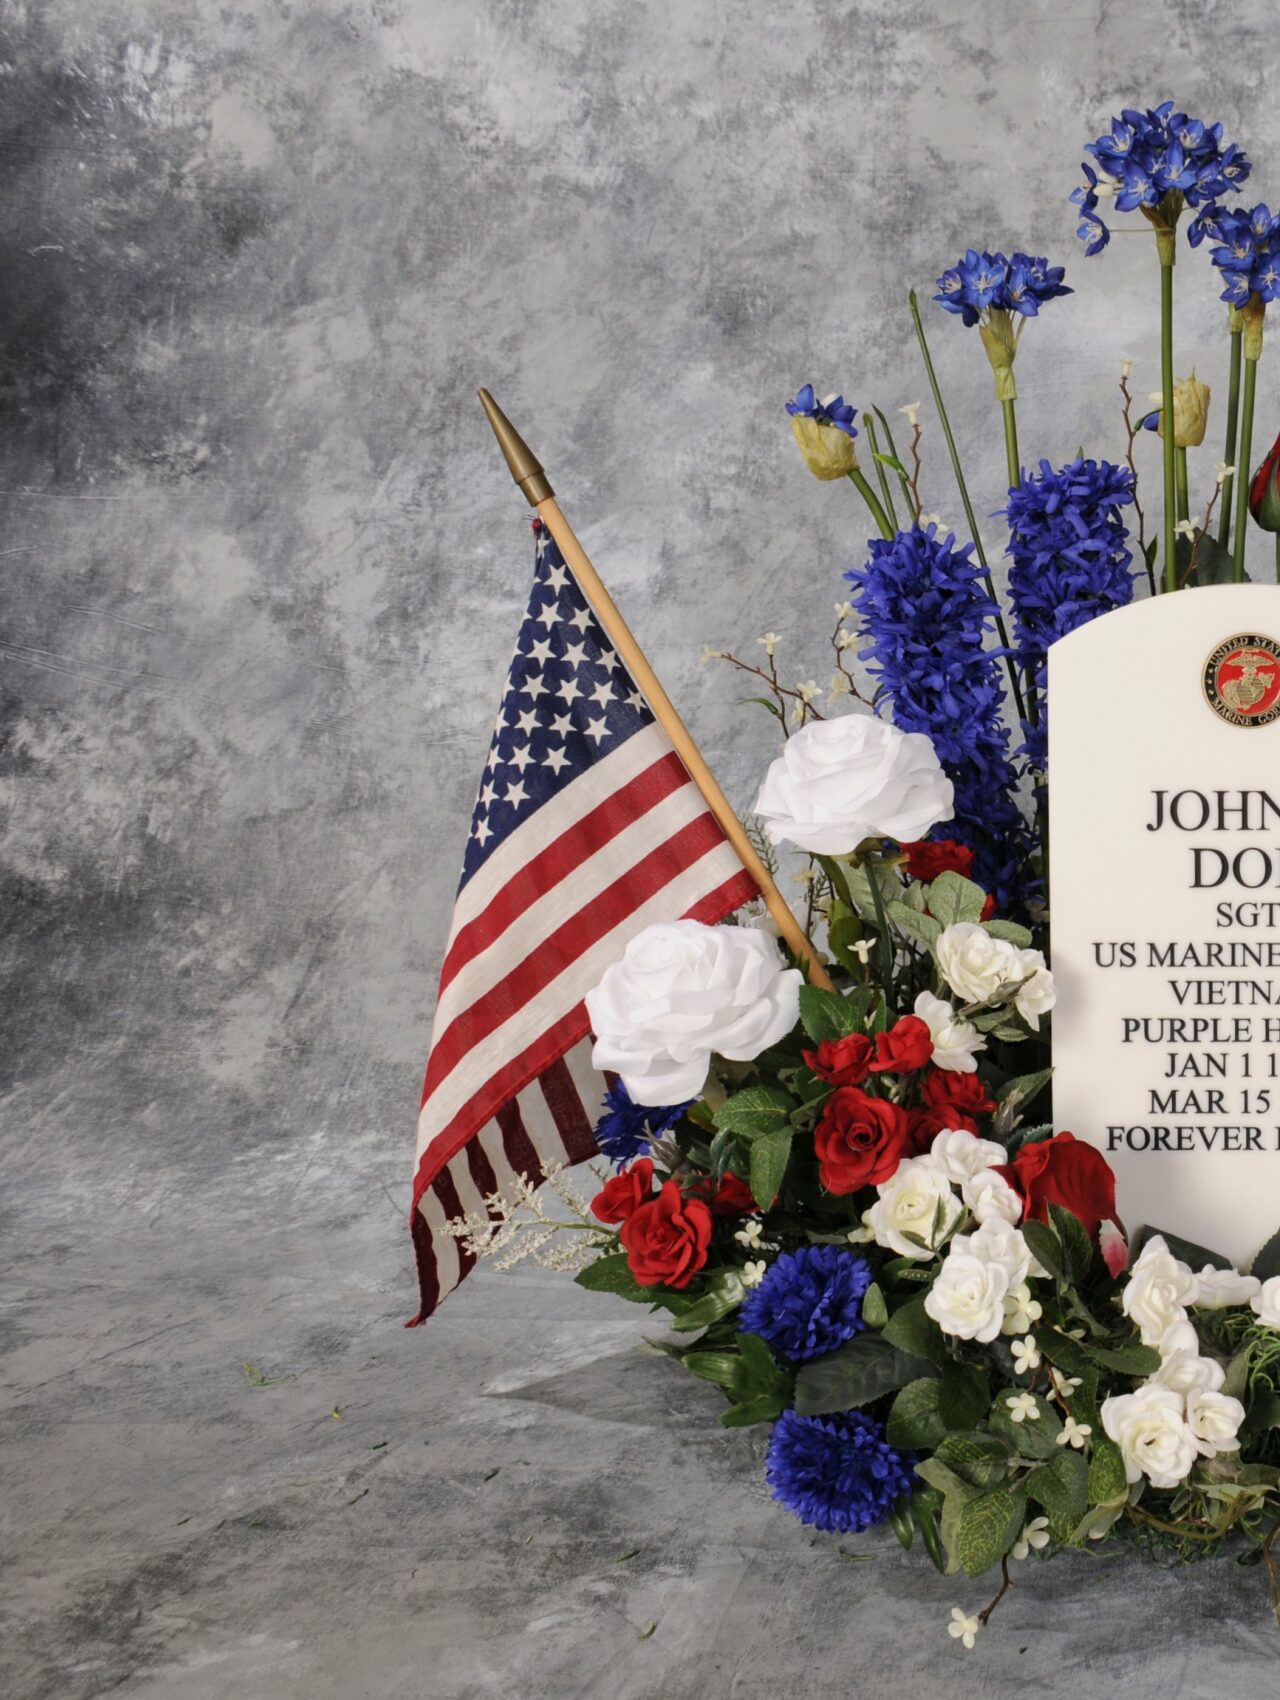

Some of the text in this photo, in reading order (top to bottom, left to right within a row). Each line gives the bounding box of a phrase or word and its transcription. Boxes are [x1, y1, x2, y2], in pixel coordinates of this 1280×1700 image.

[1210, 637, 1249, 666] UNITED
[1211, 697, 1252, 725] MARINE
[1092, 942, 1136, 968] US
[1121, 1018, 1252, 1042] PURPLE
[1164, 1053, 1228, 1078] JAN
[1241, 1053, 1252, 1077] 1
[1148, 1090, 1228, 1114] MAR
[1241, 1090, 1270, 1114] 15
[1106, 1126, 1265, 1151] FOREVER
